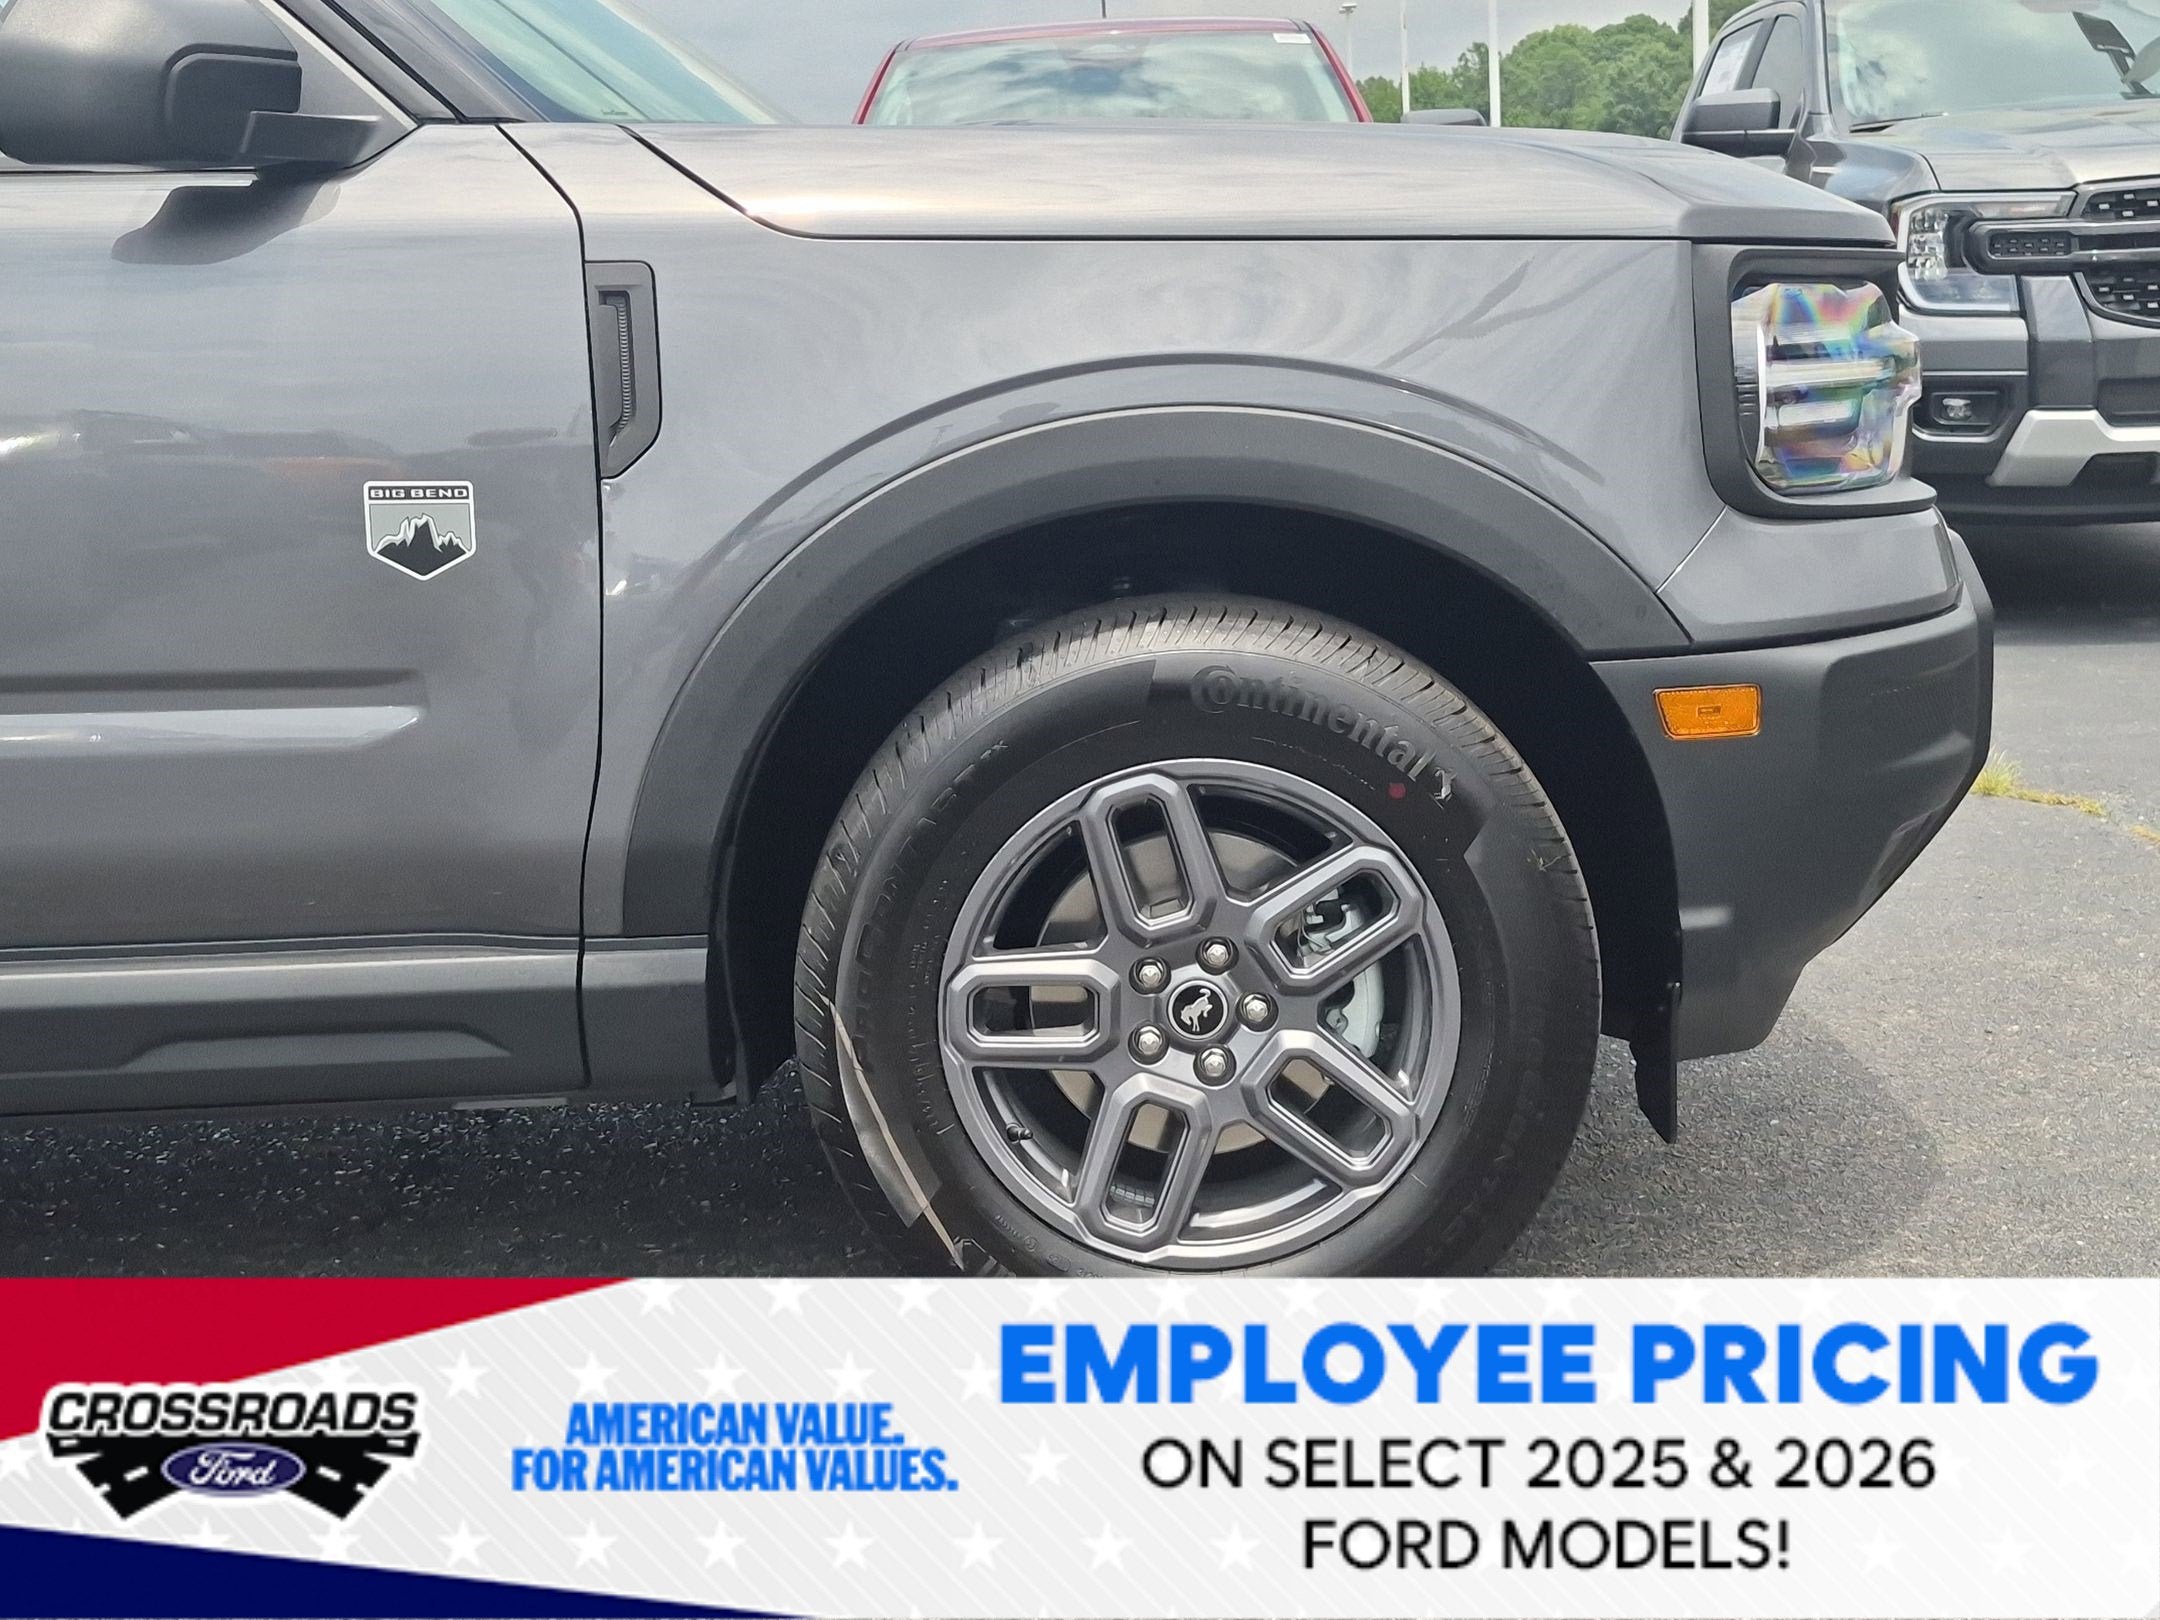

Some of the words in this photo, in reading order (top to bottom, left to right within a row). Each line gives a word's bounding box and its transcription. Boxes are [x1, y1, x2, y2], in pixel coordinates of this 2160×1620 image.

[369, 488, 406, 498] BIG
[410, 488, 468, 498] BEND
[1191, 664, 1438, 781] Continental
